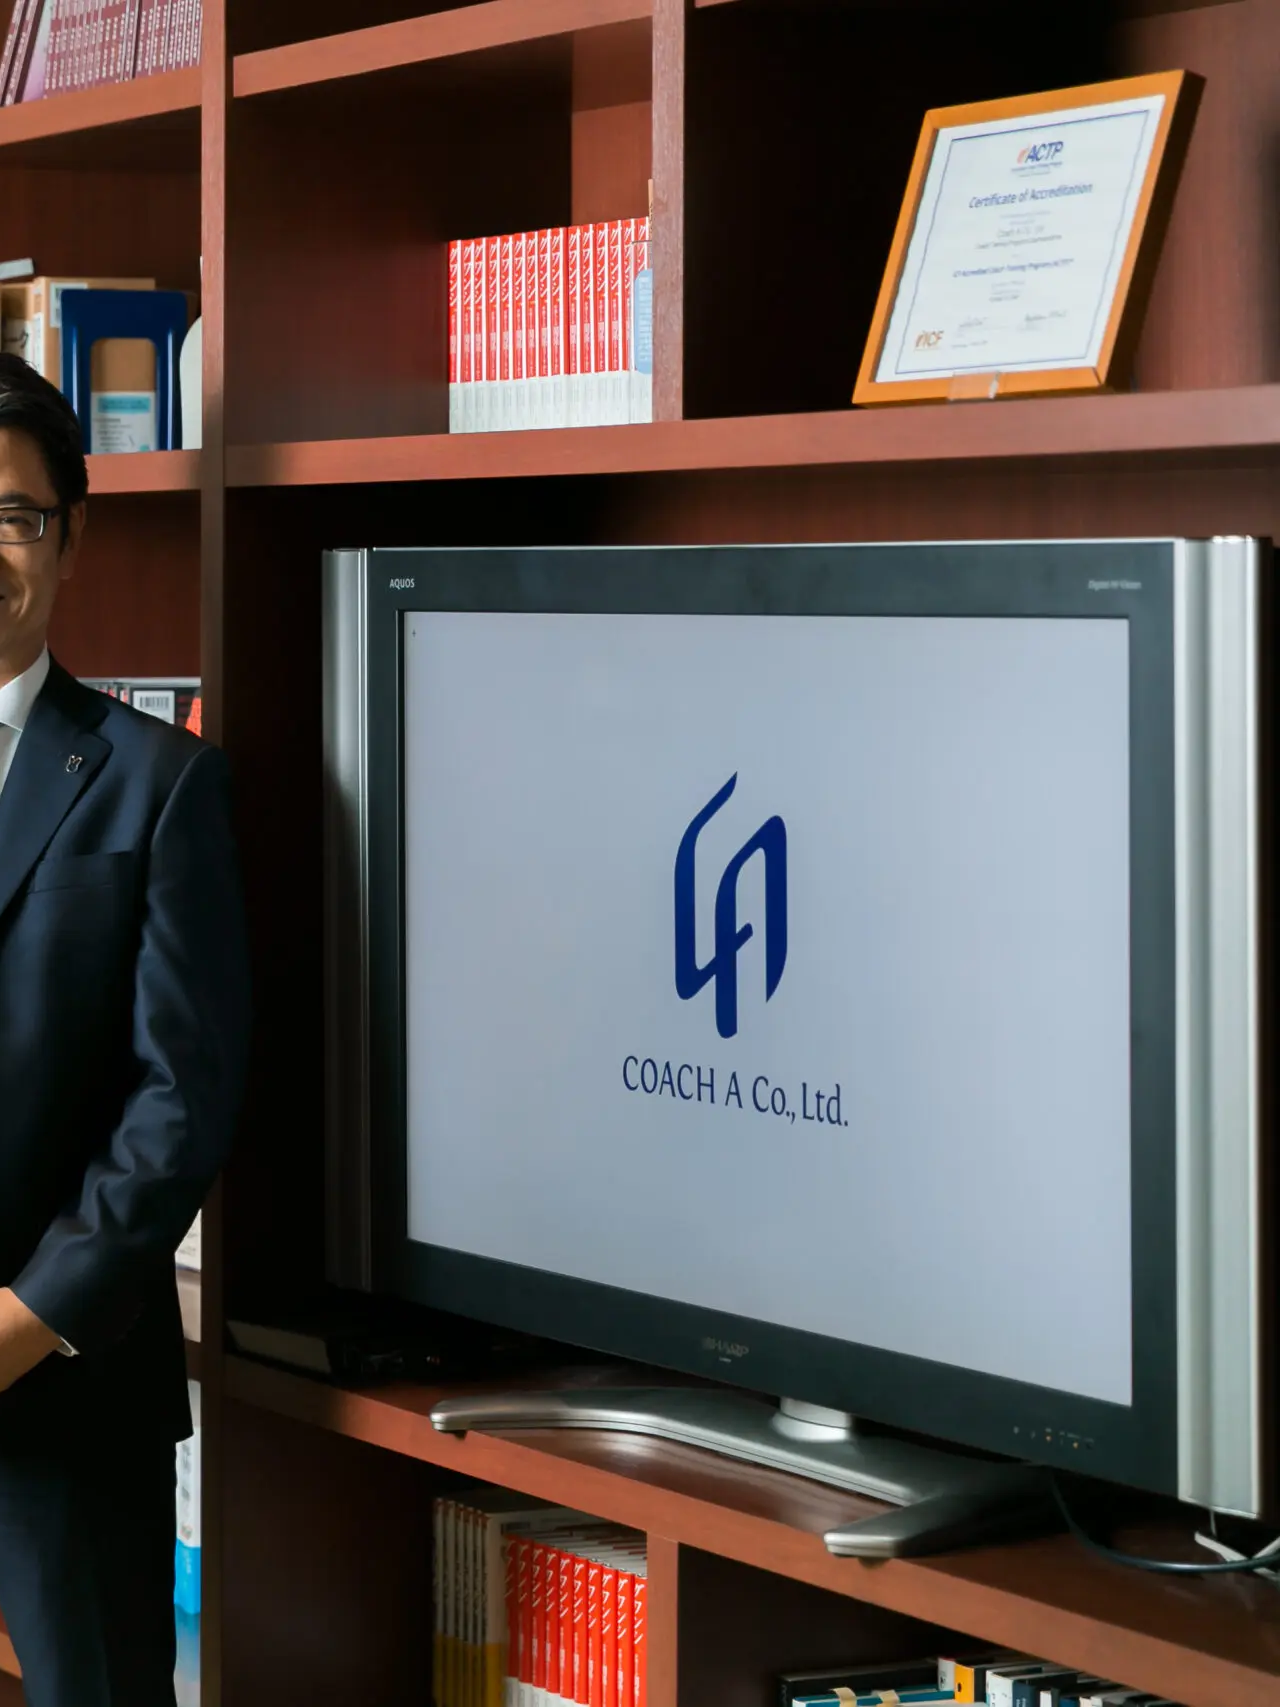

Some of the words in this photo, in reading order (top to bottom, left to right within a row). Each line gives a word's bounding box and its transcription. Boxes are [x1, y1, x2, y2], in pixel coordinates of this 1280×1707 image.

[1025, 140, 1064, 163] ACTP
[969, 192, 1017, 209] Certificate
[1019, 187, 1029, 202] of
[1030, 183, 1094, 201] Accreditation
[389, 578, 415, 590] AQUOS
[622, 1055, 716, 1104] COACH
[725, 1071, 743, 1109] A
